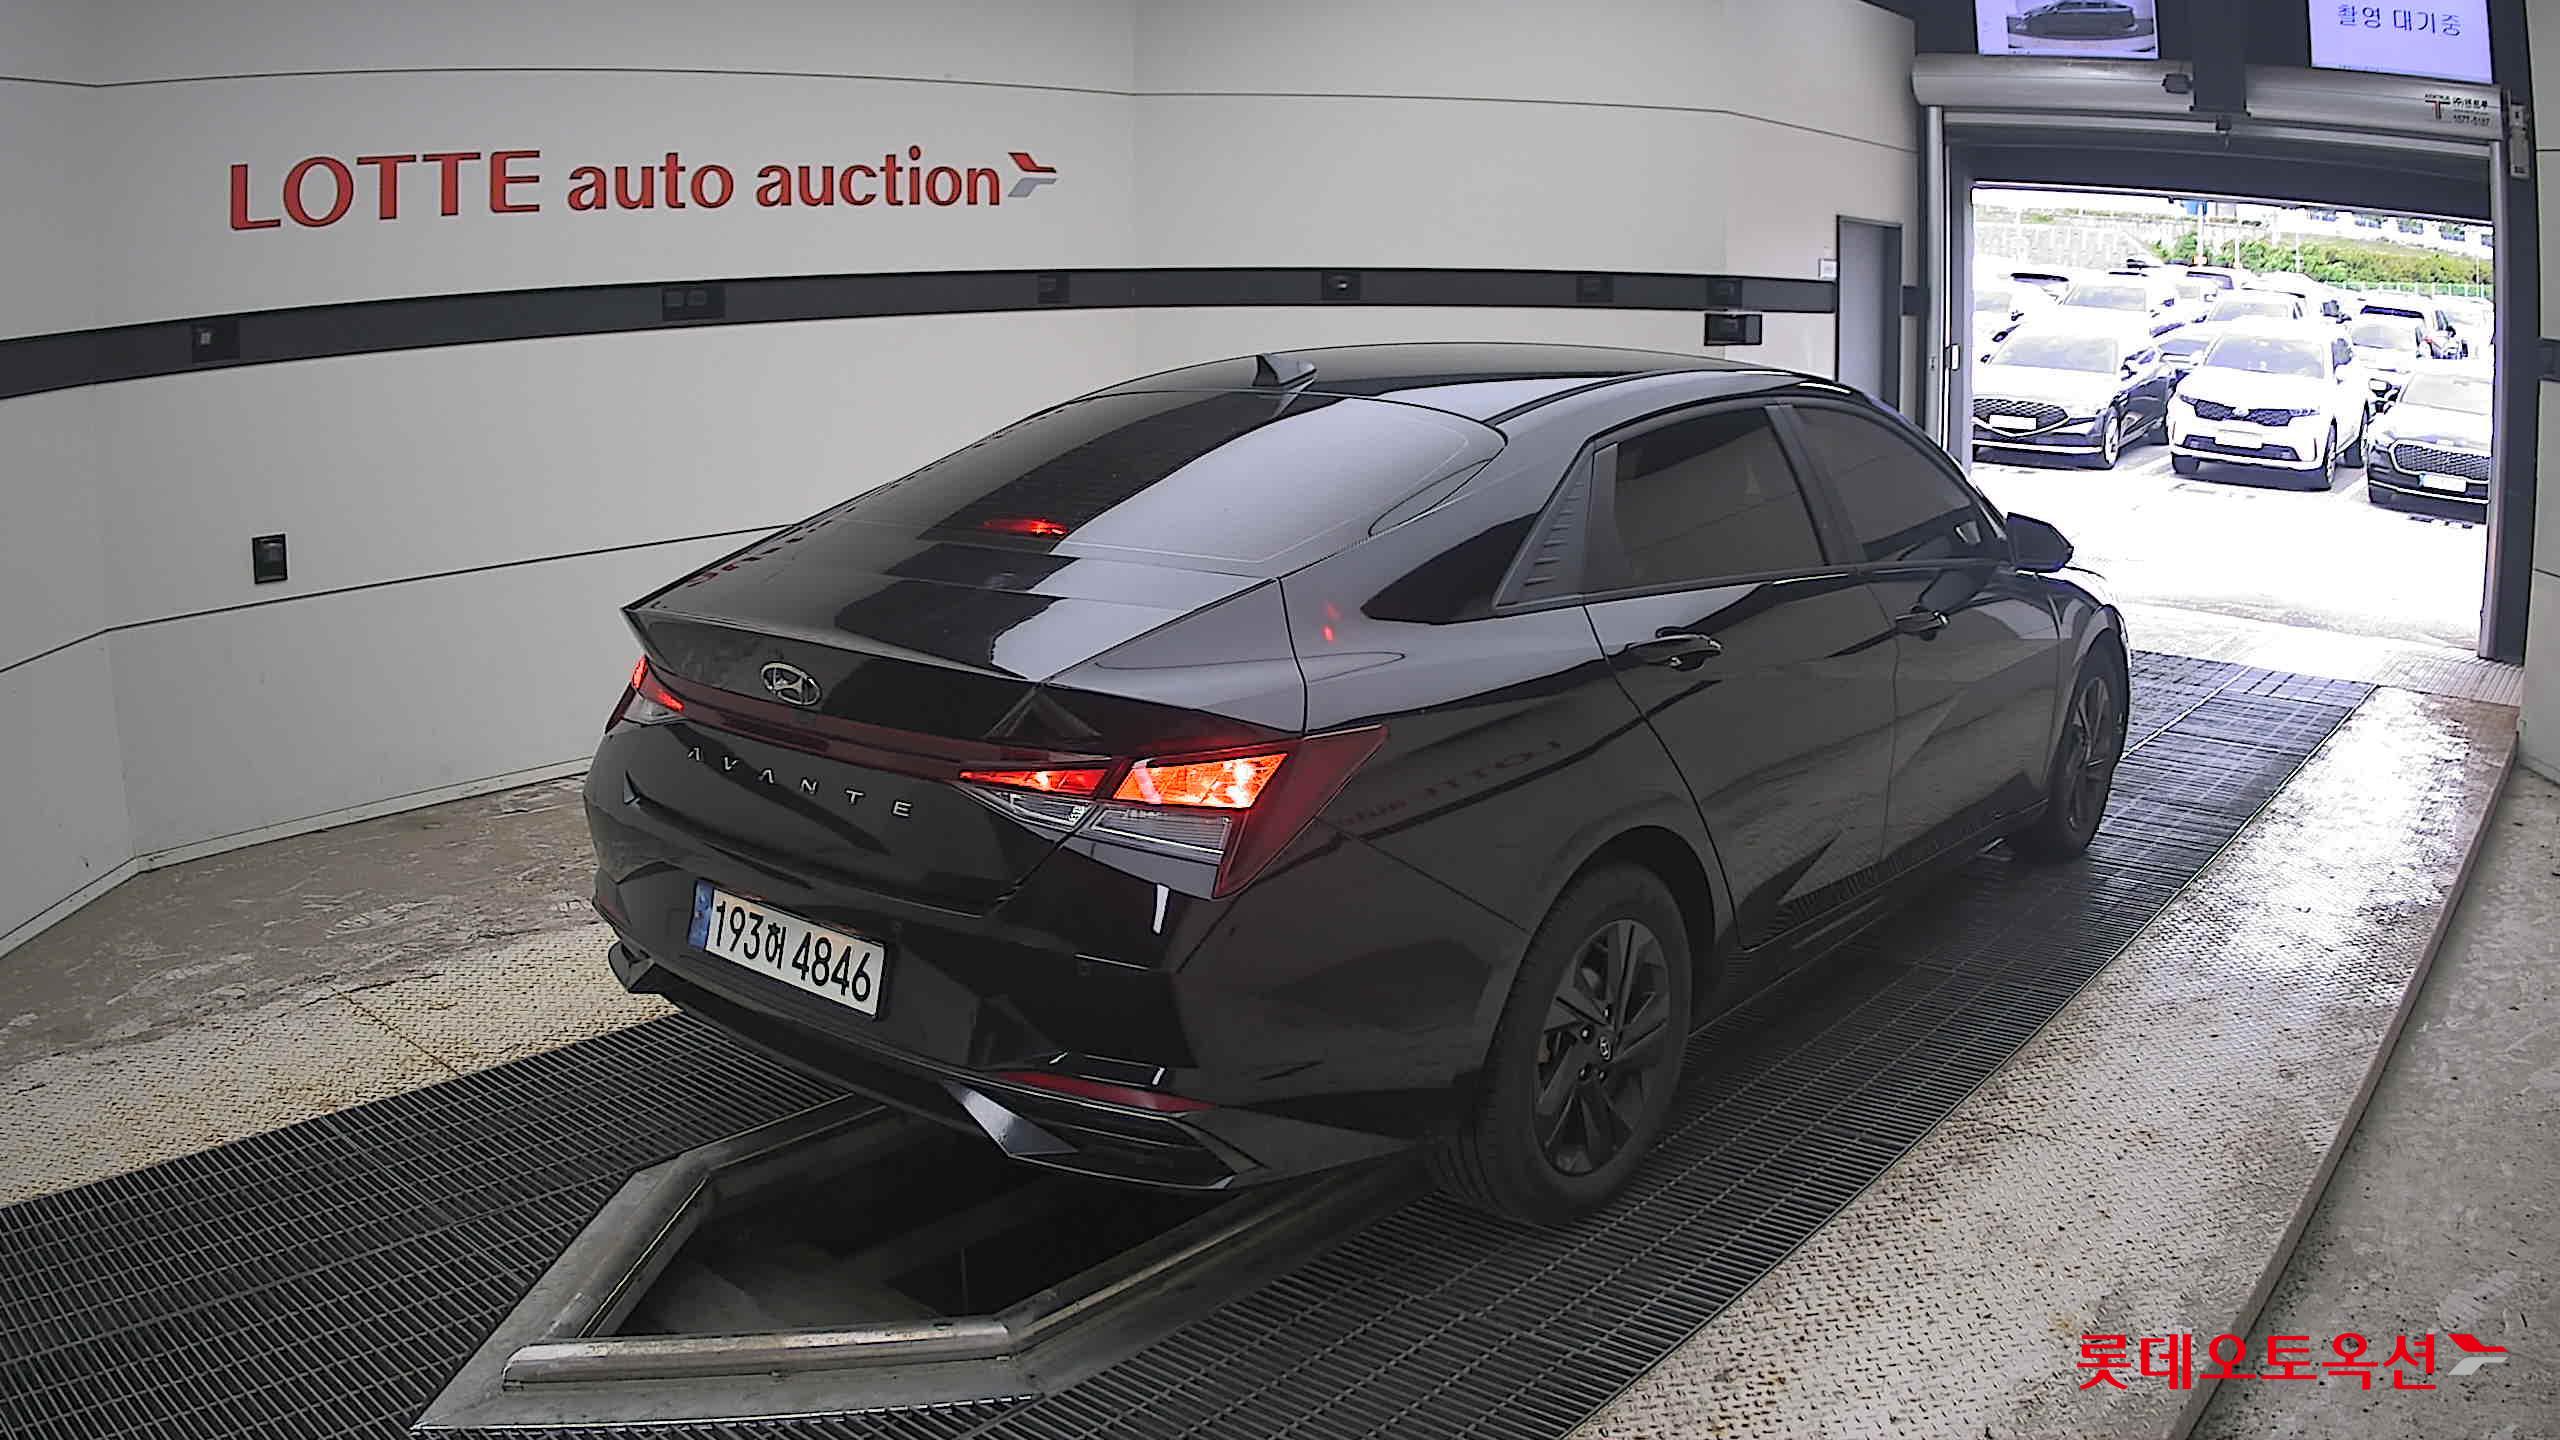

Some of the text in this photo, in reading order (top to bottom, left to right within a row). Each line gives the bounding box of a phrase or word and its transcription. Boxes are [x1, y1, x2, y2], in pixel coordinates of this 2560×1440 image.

[2338, 4, 2461, 37] 촬영 대기중
[230, 146, 1002, 231] LOTTE auto auction
[687, 747, 912, 817] AVANTE
[791, 932, 872, 1001] 4846
